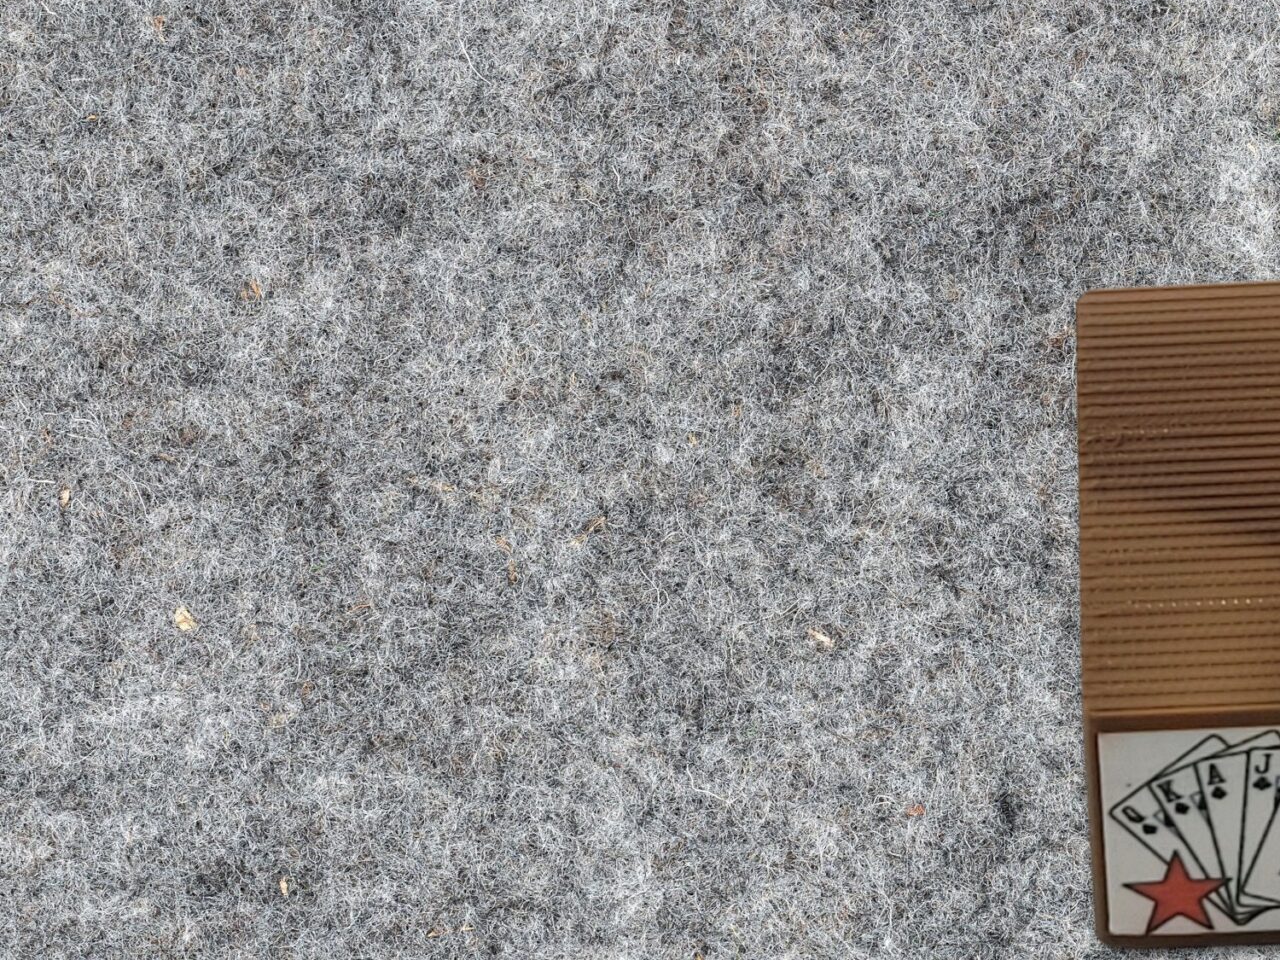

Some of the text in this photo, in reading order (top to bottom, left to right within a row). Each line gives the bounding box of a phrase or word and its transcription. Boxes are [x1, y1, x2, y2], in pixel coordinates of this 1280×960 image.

[1207, 763, 1226, 786] A
[1254, 753, 1274, 774] J
[1156, 779, 1183, 803] K
[1121, 805, 1148, 824] Q
